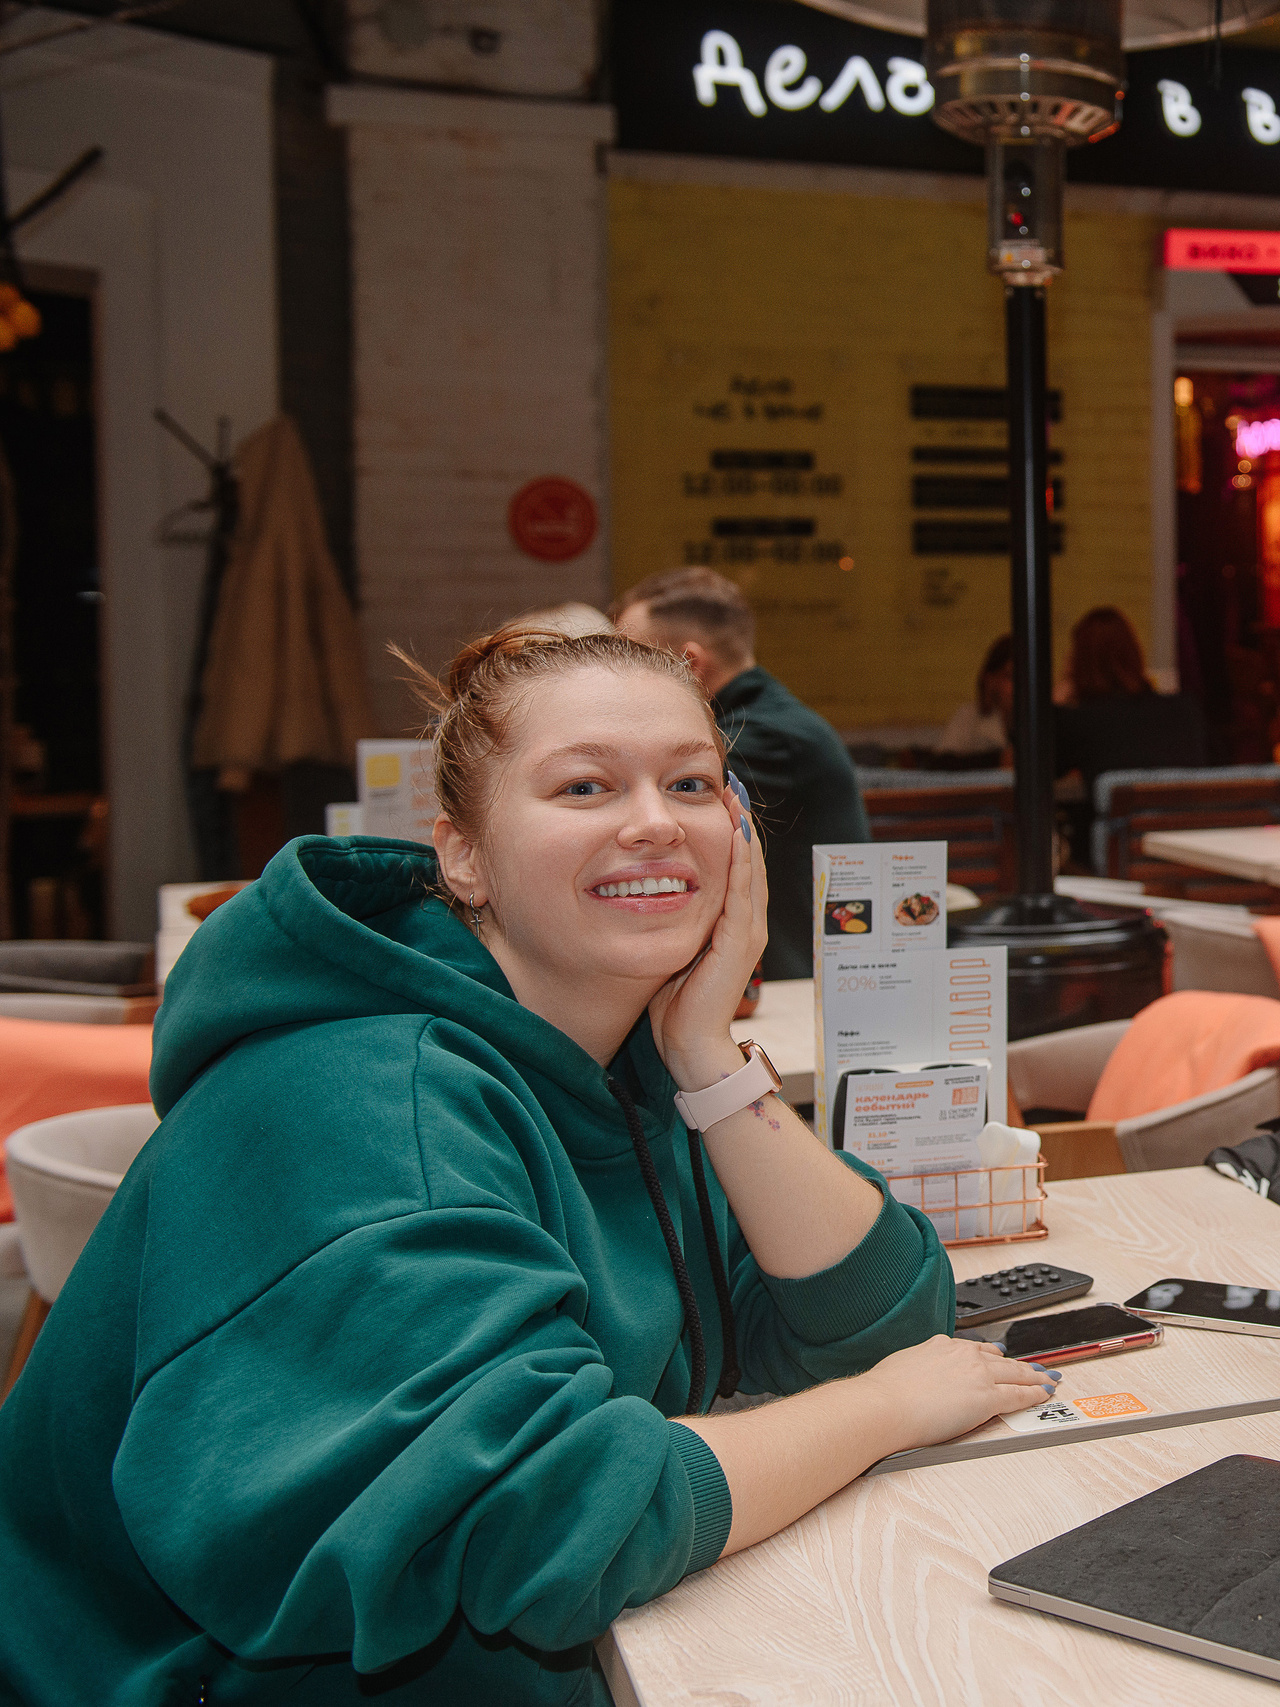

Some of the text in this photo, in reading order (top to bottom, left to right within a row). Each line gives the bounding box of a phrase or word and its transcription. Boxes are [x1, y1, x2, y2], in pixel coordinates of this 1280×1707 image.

[693, 28, 936, 118] Дело
[1157, 79, 1203, 138] в
[837, 975, 877, 993] 20%
[948, 957, 992, 1063] РОДВОР
